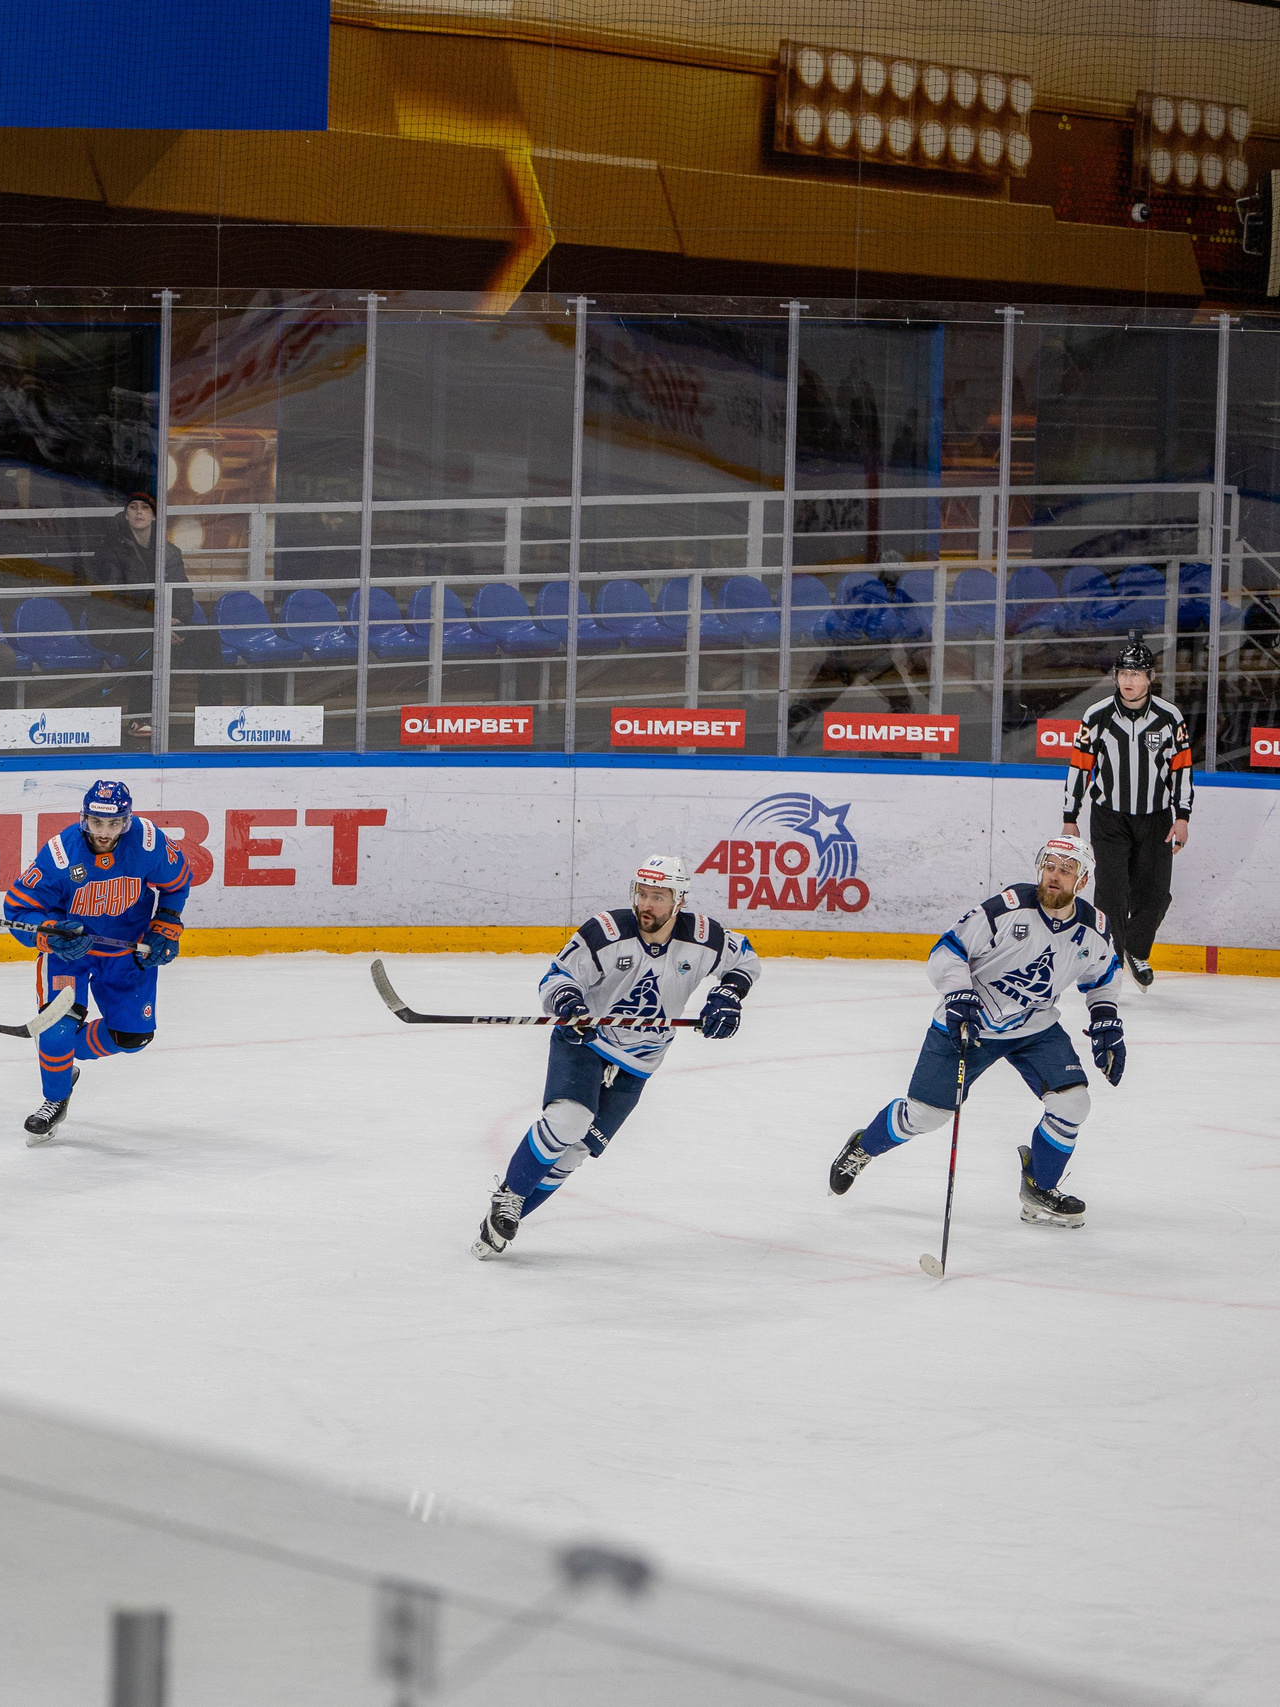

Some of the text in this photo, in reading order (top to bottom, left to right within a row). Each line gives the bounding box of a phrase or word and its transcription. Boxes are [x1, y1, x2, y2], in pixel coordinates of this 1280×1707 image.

[404, 718, 529, 734] OLIMPBET
[614, 719, 741, 736] OLIMPBET
[826, 723, 955, 742] OLIMPBET
[47, 731, 90, 744] ГАЗПРОМ
[246, 729, 291, 742] ГАЗПРОМ
[98, 789, 113, 798] 40
[91, 803, 116, 812] OLIMPBET
[694, 839, 811, 877] АВТО
[638, 870, 664, 879] OLIMPBET
[69, 875, 142, 918] НЕВА
[727, 875, 870, 914] РАДИО
[1, 919, 39, 933] CCM
[1070, 925, 1087, 946] A
[712, 986, 740, 1003] UER
[988, 980, 1040, 1008] АЛТ
[1092, 1020, 1123, 1030] BAU
[957, 1059, 965, 1084] CCM
